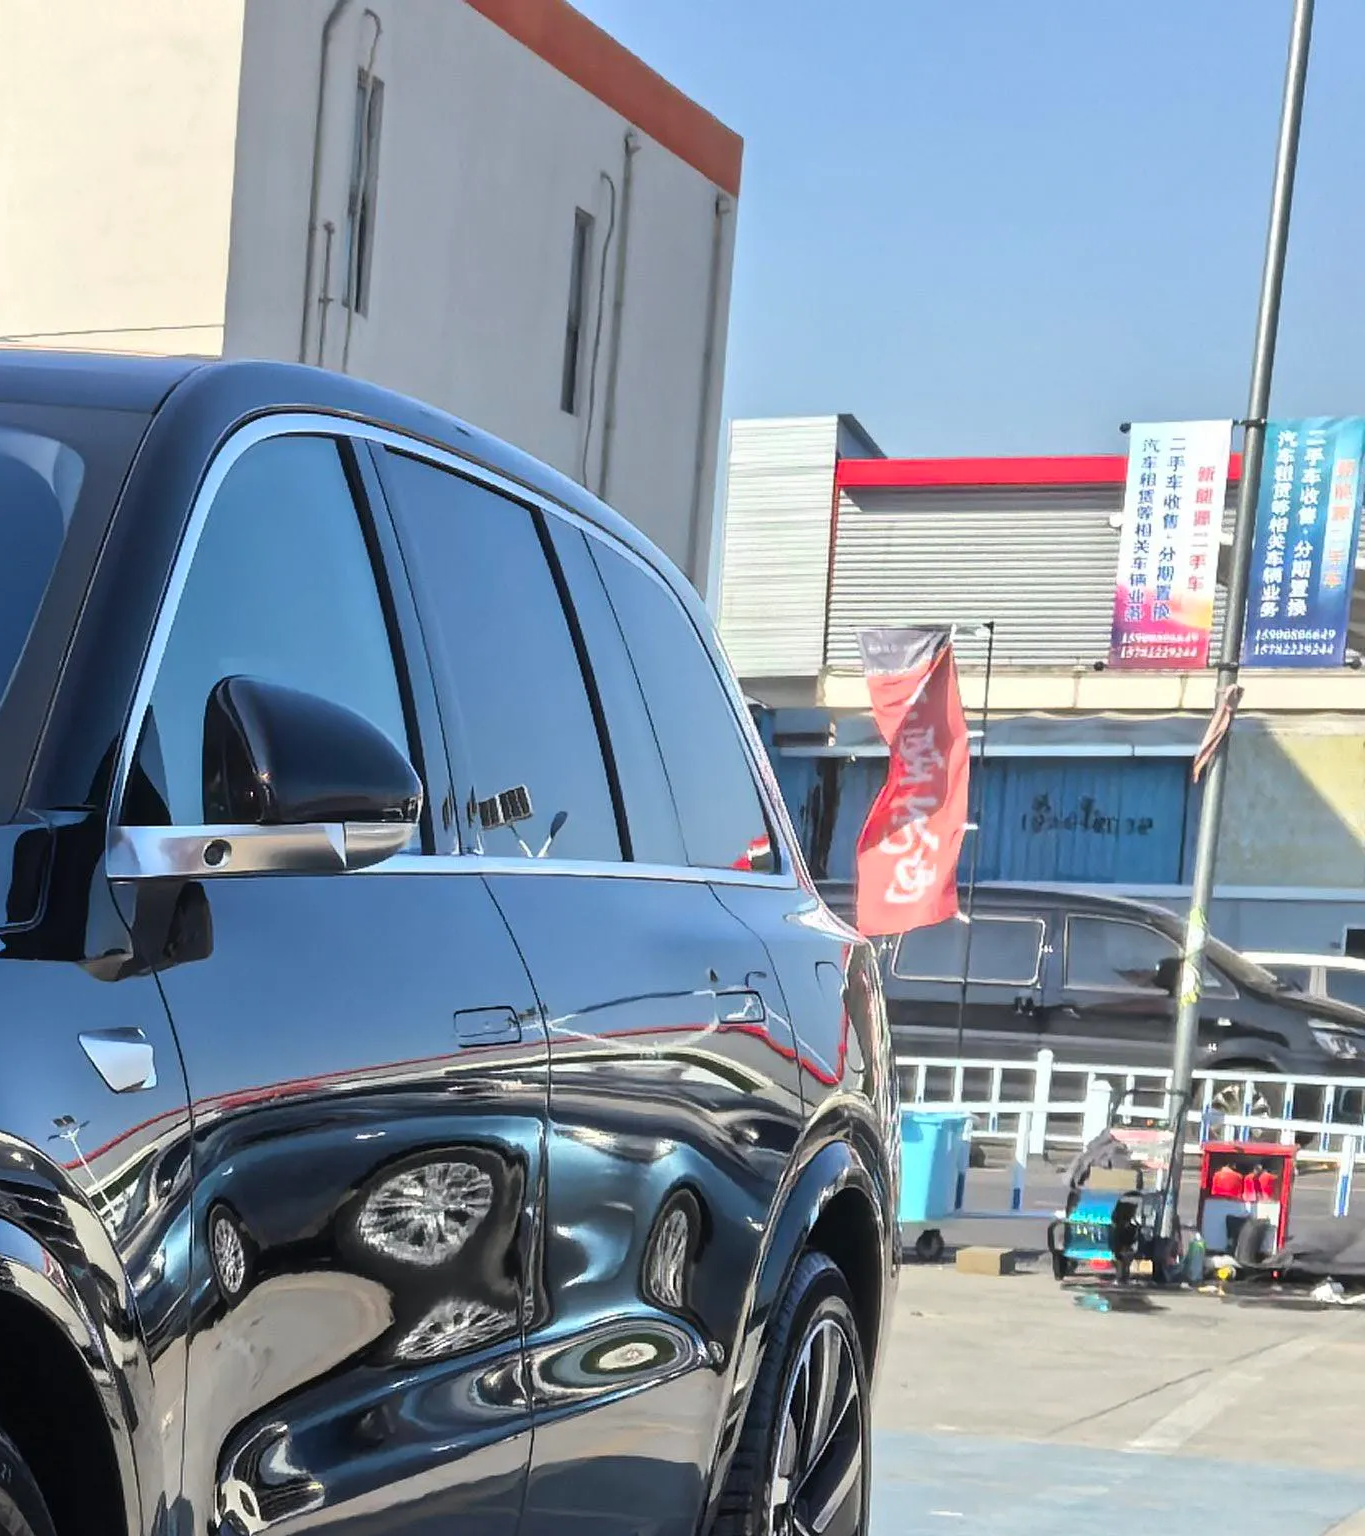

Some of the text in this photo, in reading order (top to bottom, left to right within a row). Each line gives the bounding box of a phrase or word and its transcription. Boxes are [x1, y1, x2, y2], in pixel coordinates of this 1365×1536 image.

[1124, 438, 1161, 621] 汽车租赁等相关车辆业务
[1186, 465, 1216, 592] 新能源二手车
[1259, 430, 1298, 618] 汽车租赁等相关车辆业务
